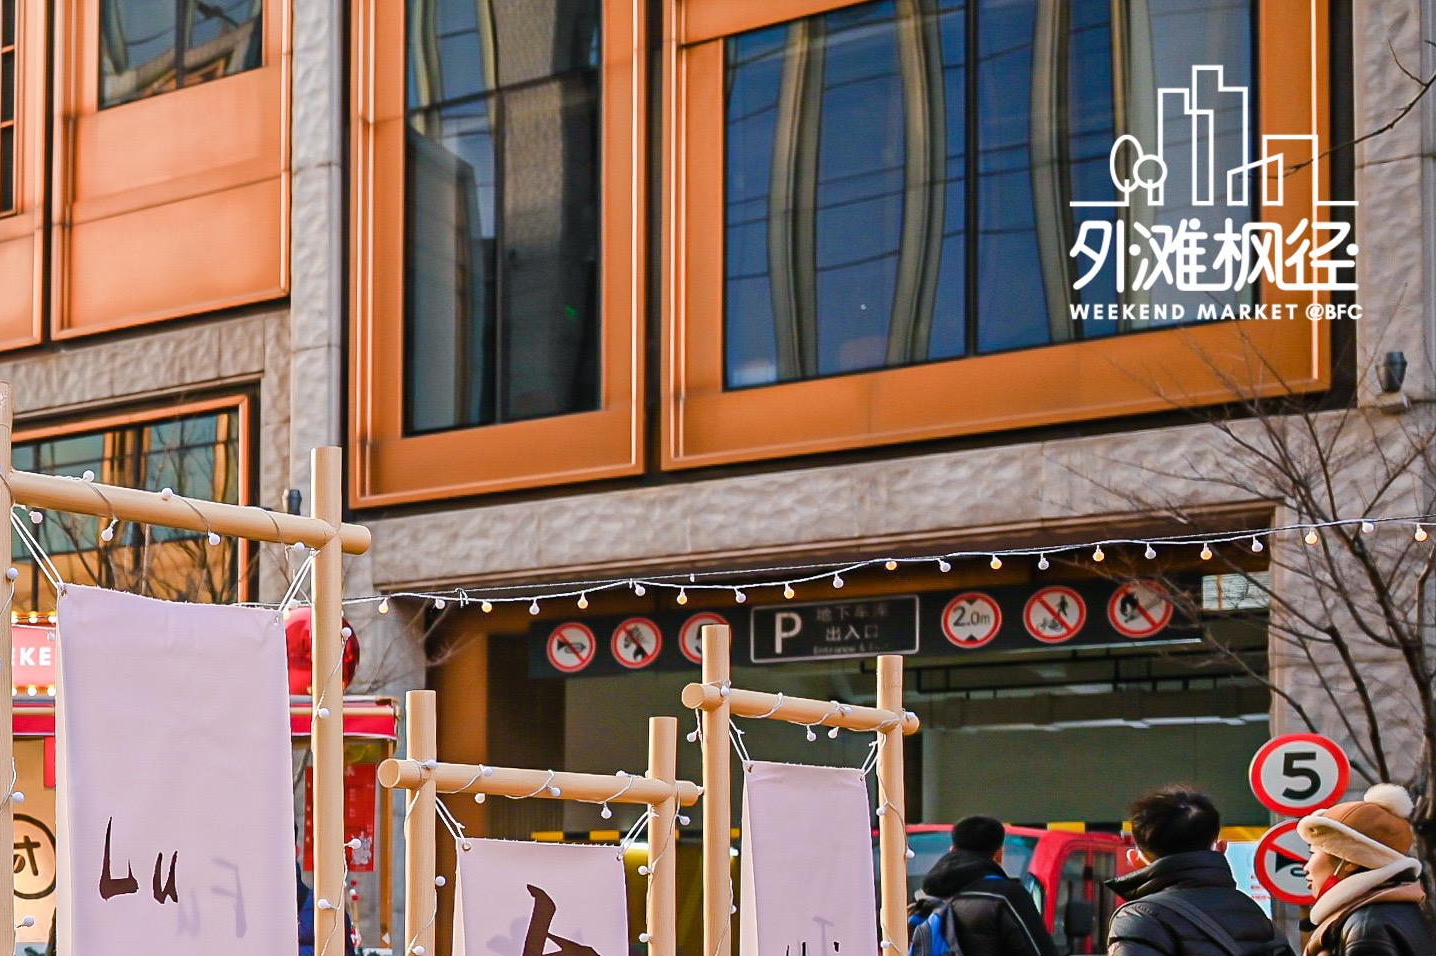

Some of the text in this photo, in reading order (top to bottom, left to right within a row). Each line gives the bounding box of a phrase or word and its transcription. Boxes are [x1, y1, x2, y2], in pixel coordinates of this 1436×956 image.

[774, 612, 802, 654] P
[825, 624, 879, 642] 出入口
[953, 606, 990, 627] 2.0m
[1282, 752, 1321, 800] 5
[99, 817, 179, 904] Lu
